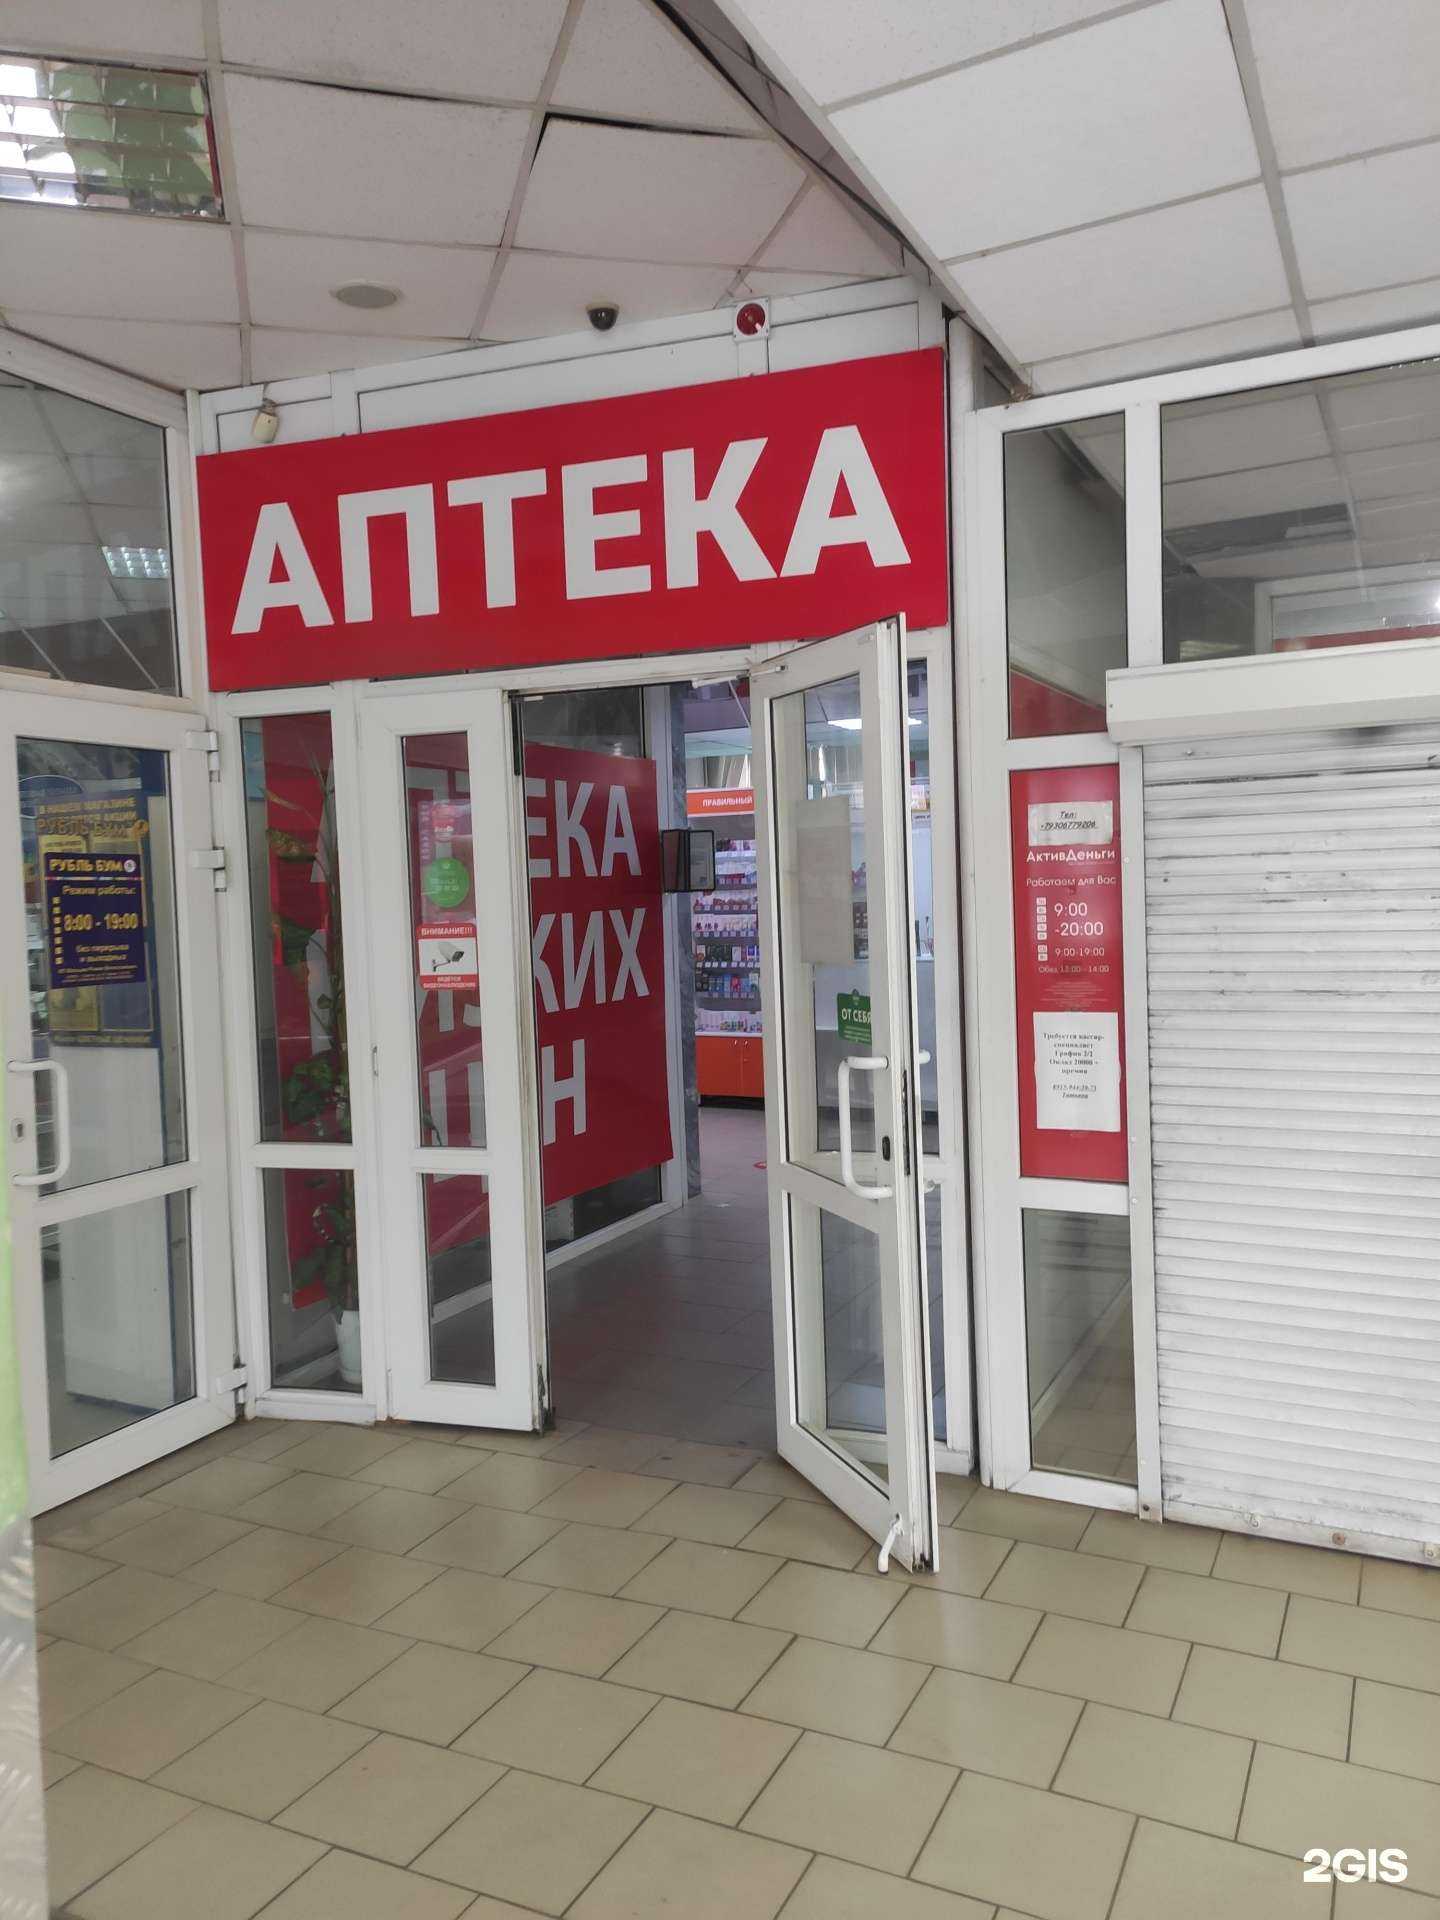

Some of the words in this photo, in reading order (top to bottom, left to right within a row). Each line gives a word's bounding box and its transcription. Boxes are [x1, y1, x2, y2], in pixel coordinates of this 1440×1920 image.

[231, 424, 911, 635] АПТЕКА
[702, 795, 753, 807] ПРАВИЛЬНЫЙ
[1026, 849, 1116, 863] АктивДеньги
[49, 859, 94, 872] РУБЛЬ
[95, 859, 123, 872] БУМ
[1026, 877, 1076, 888] Работаем
[1077, 877, 1095, 887] для
[1097, 875, 1117, 886] Вас
[1054, 902, 1089, 918] 9:00
[64, 913, 94, 932] 8:00
[104, 912, 138, 930] 19:00
[841, 1008, 852, 1021] ОТ
